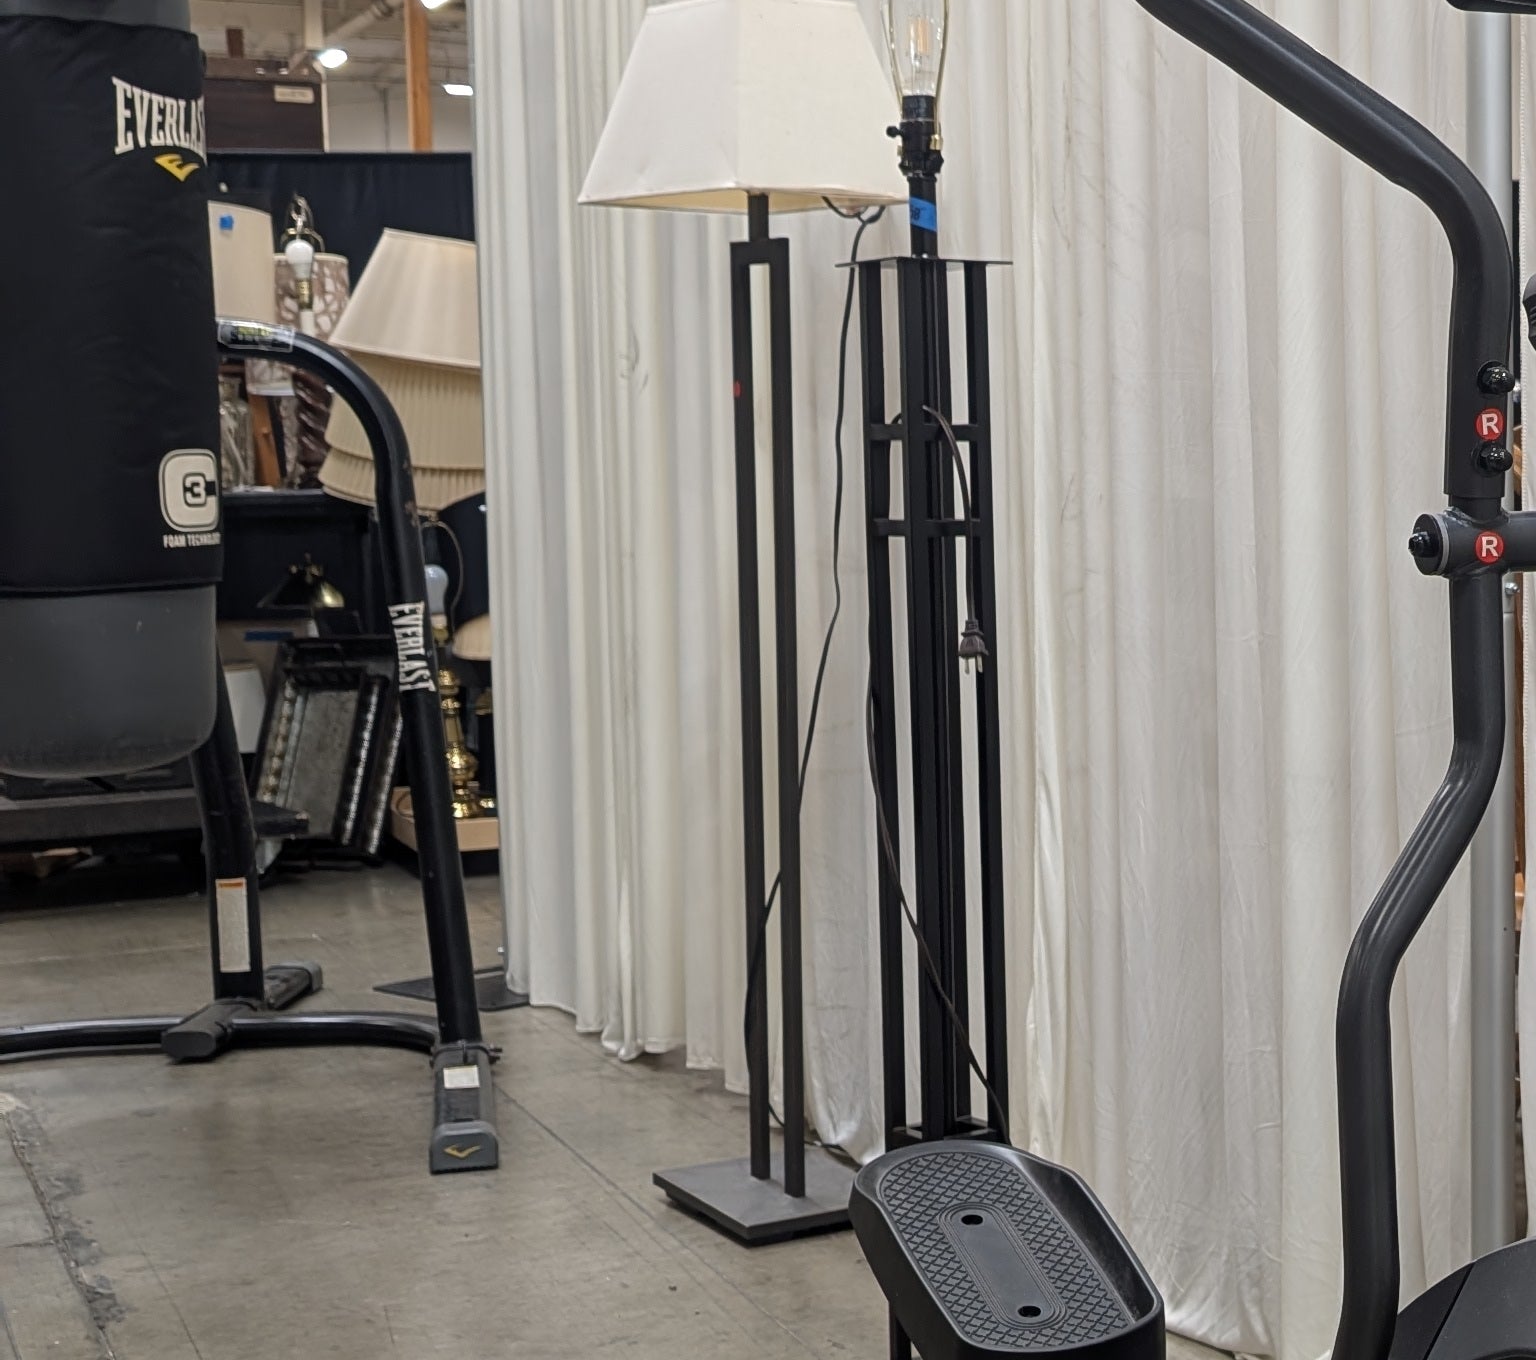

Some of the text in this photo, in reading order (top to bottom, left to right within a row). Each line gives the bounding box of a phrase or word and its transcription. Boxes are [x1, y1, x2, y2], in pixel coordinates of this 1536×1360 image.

[1481, 413, 1499, 435] R
[1481, 536, 1499, 557] R
[388, 601, 436, 693] EVERLAST
